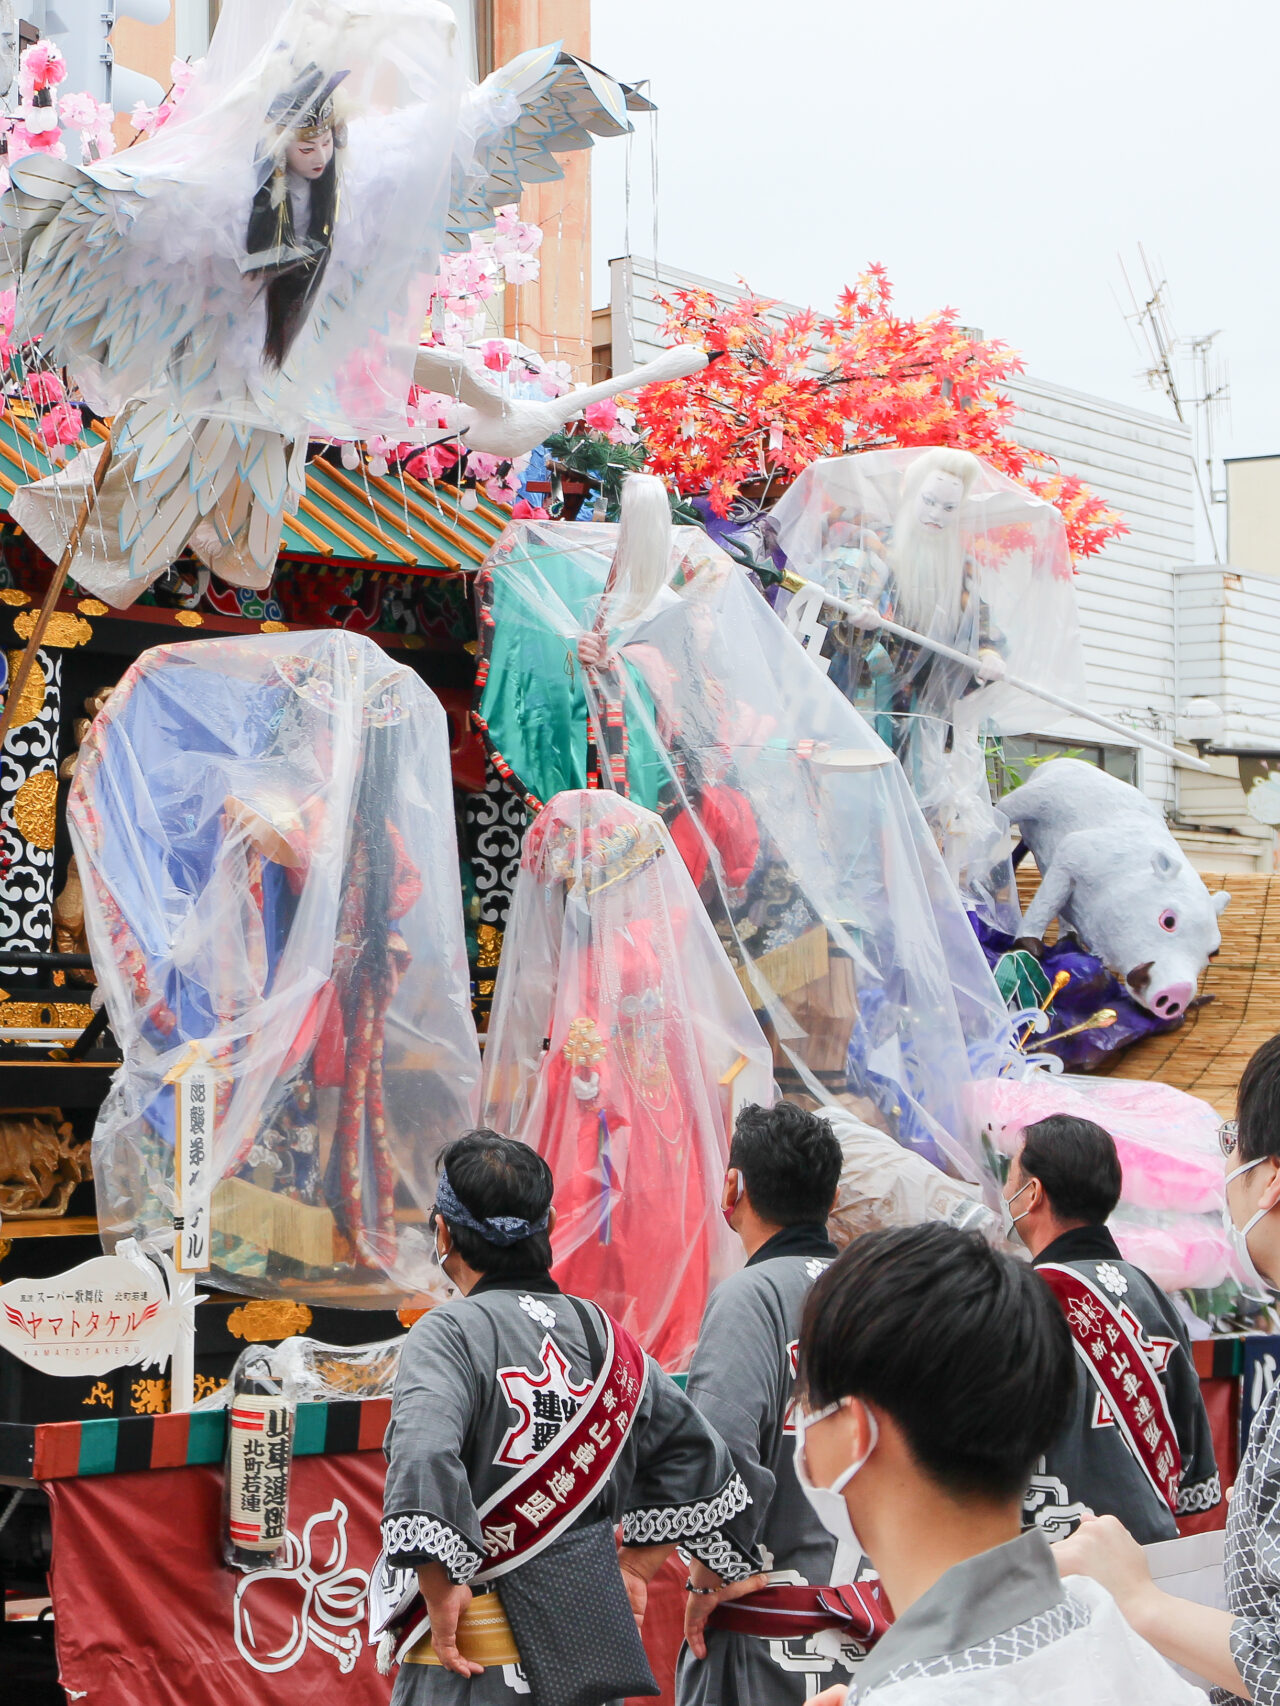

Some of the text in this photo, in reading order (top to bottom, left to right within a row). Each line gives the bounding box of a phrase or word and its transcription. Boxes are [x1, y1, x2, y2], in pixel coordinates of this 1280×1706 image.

[37, 1289, 104, 1304] スーパー歌舞伎
[27, 1309, 141, 1340] ヤマトタケル
[240, 1438, 266, 1513] 北町若連
